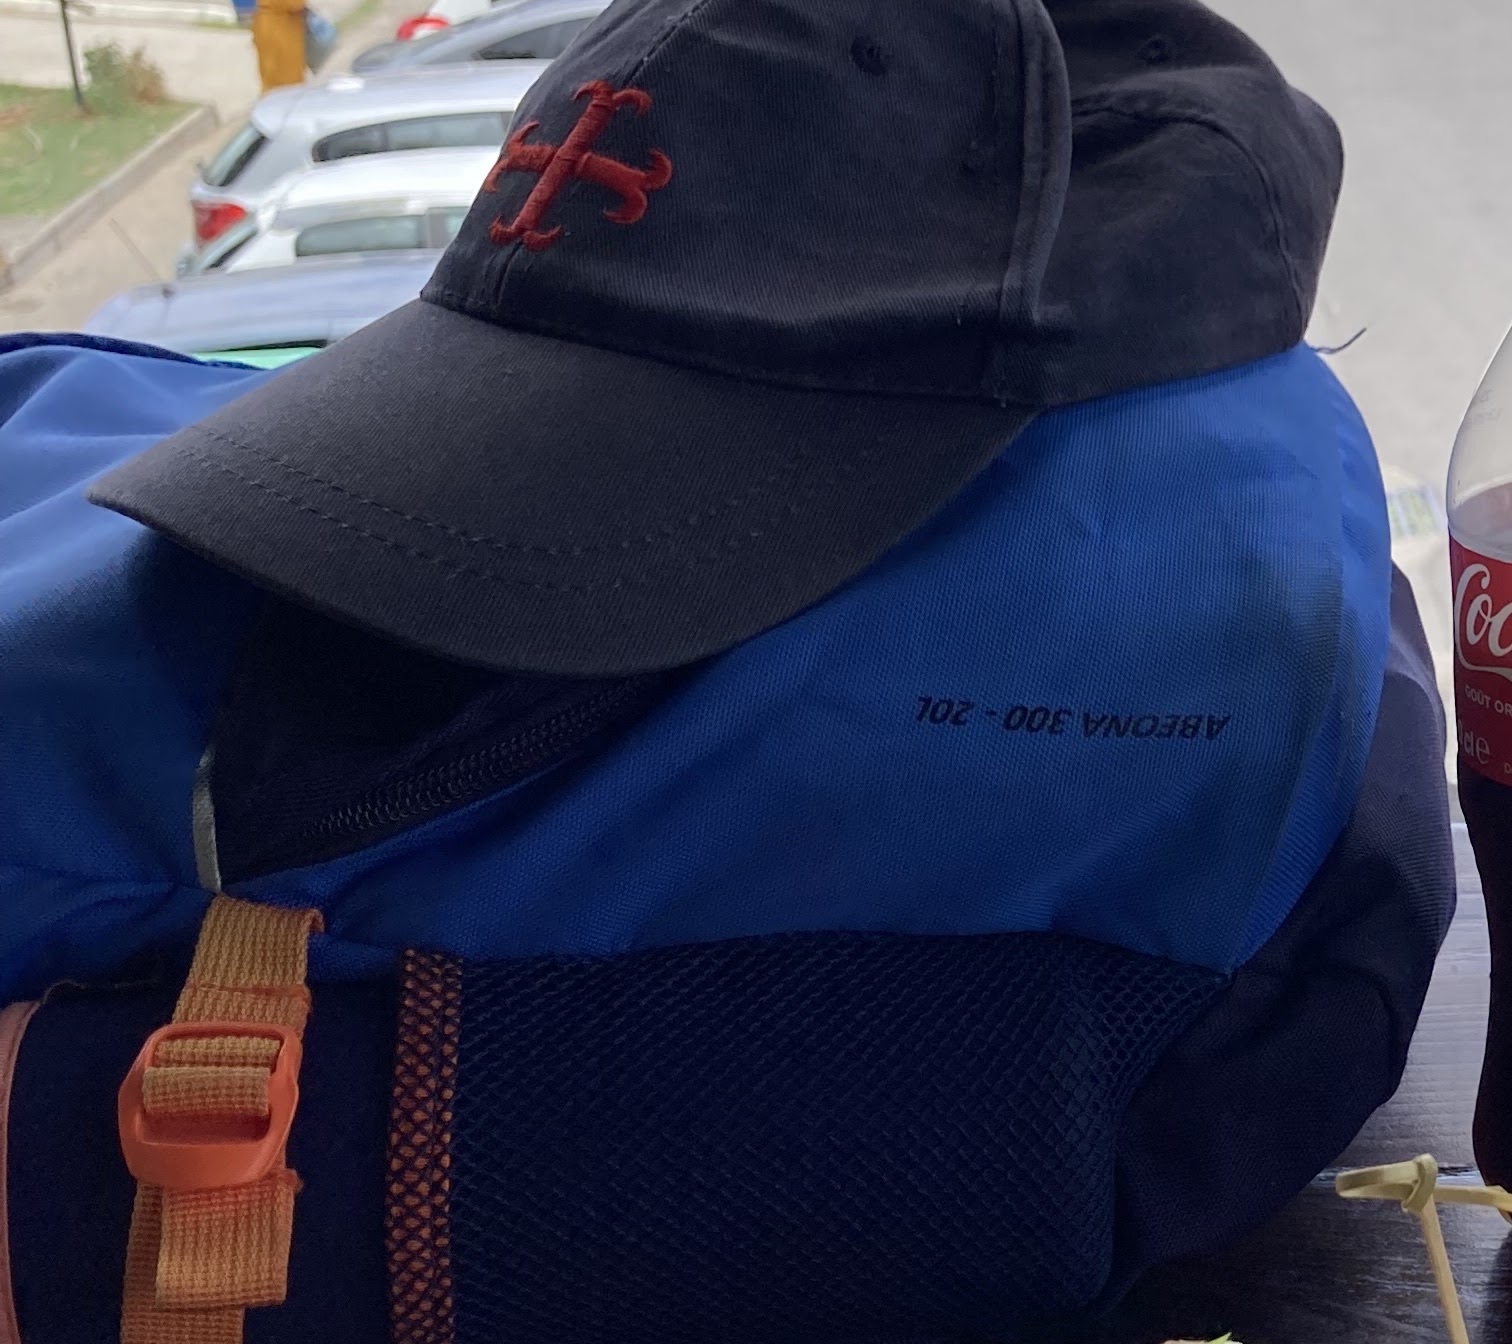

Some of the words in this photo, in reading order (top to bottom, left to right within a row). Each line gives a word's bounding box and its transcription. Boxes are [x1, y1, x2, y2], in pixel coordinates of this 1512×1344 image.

[916, 694, 976, 727] 20L
[1002, 705, 1073, 736] 300
[1082, 710, 1231, 741] ABEONA
